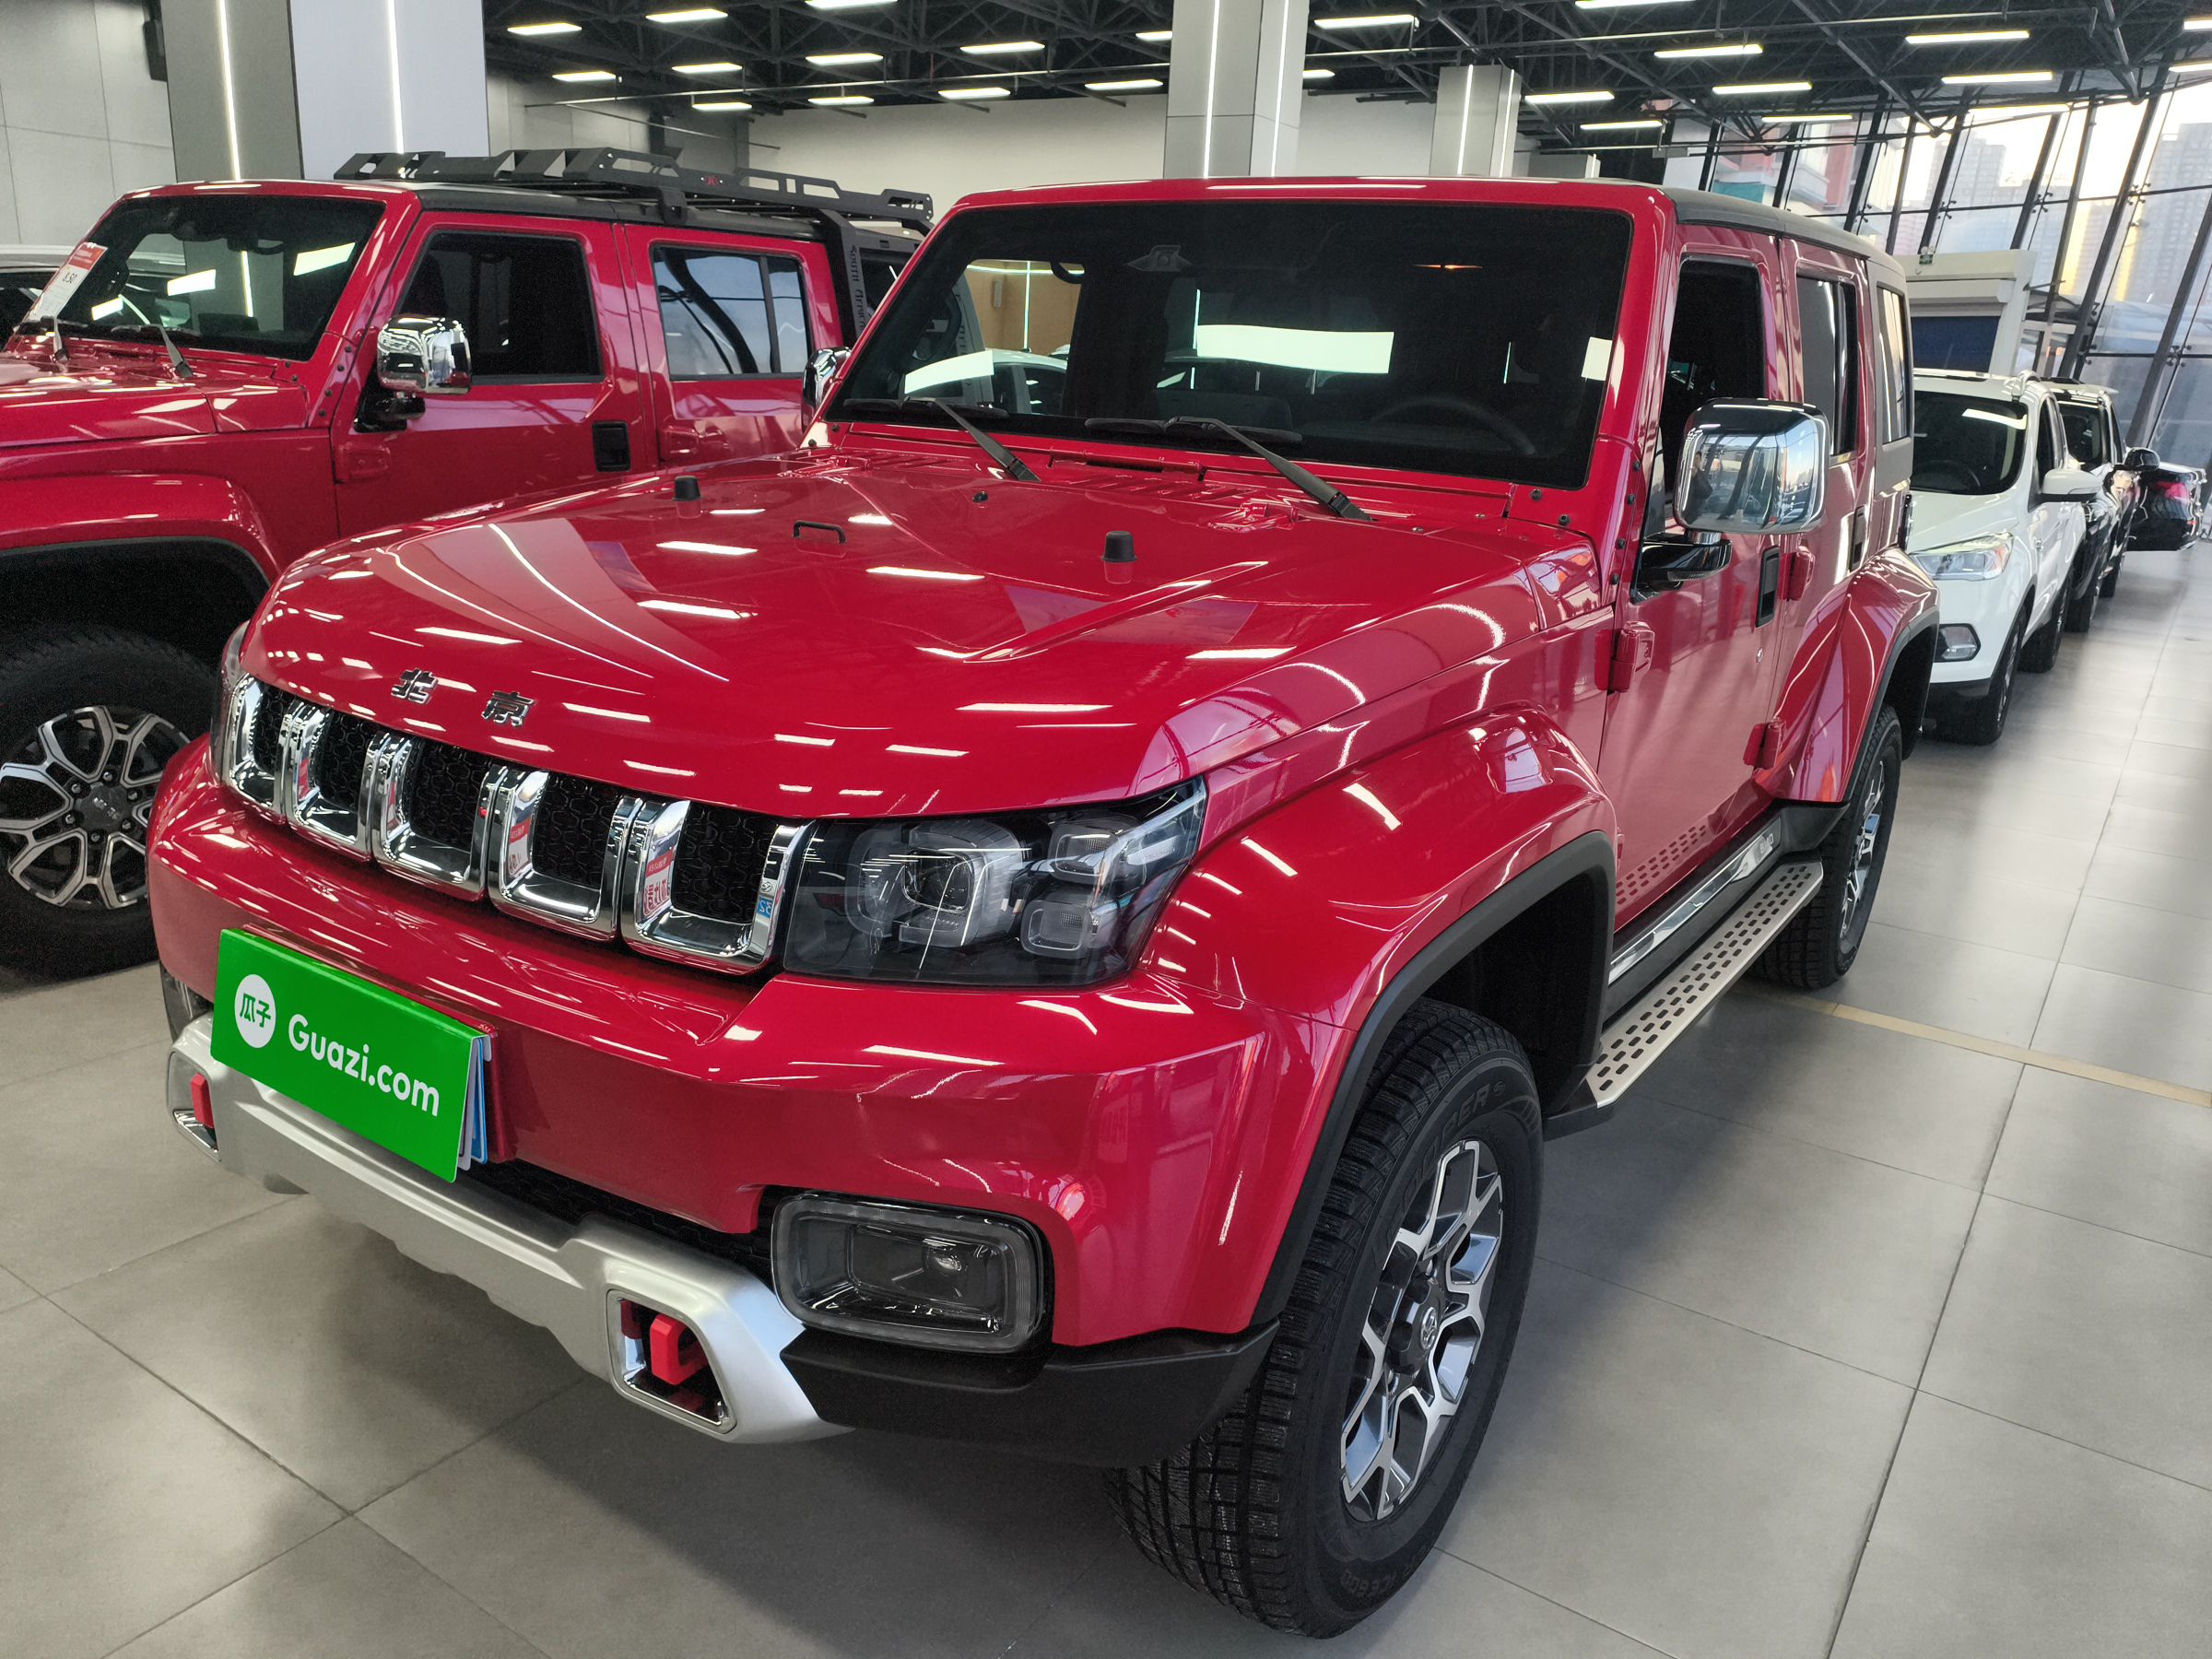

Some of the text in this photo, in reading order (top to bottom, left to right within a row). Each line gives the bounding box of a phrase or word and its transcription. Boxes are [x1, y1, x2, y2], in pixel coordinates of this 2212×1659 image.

[391, 666, 536, 728] 北京
[240, 993, 272, 1029] 瓜子
[288, 1013, 441, 1118] Guazi.com
